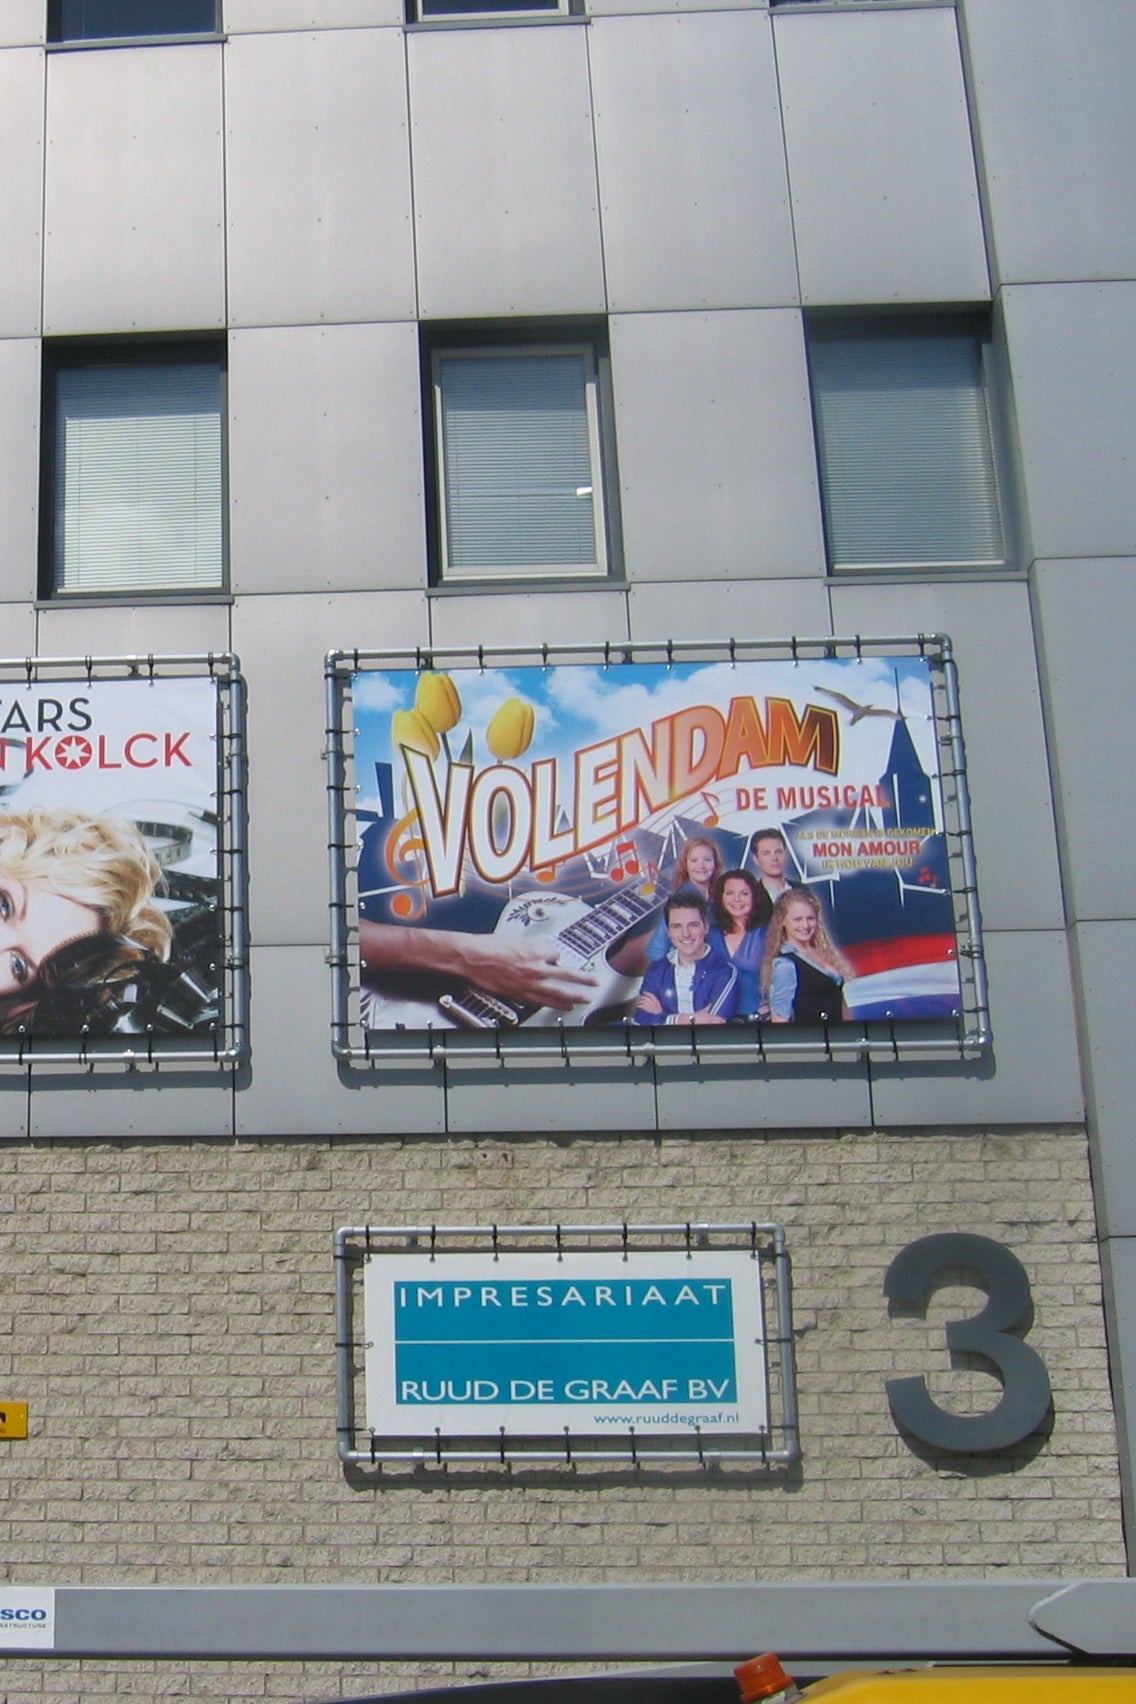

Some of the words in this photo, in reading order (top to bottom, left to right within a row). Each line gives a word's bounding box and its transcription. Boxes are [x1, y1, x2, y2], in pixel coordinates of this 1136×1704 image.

[25, 732, 194, 770] KOLCK
[399, 697, 840, 898] VOLENDAM
[736, 788, 768, 811] DE
[777, 784, 891, 810] MUSICAL
[813, 842, 852, 858] MON
[857, 840, 921, 857] AMOUR
[400, 1285, 727, 1307] IMPRESARIAAT
[883, 1233, 1053, 1452] 3
[401, 1381, 499, 1401] RUUD
[510, 1380, 554, 1400] DE
[565, 1379, 678, 1400] GRAAF
[688, 1379, 730, 1399] BV
[594, 1412, 740, 1426] www.ruuddegraaf.nl
